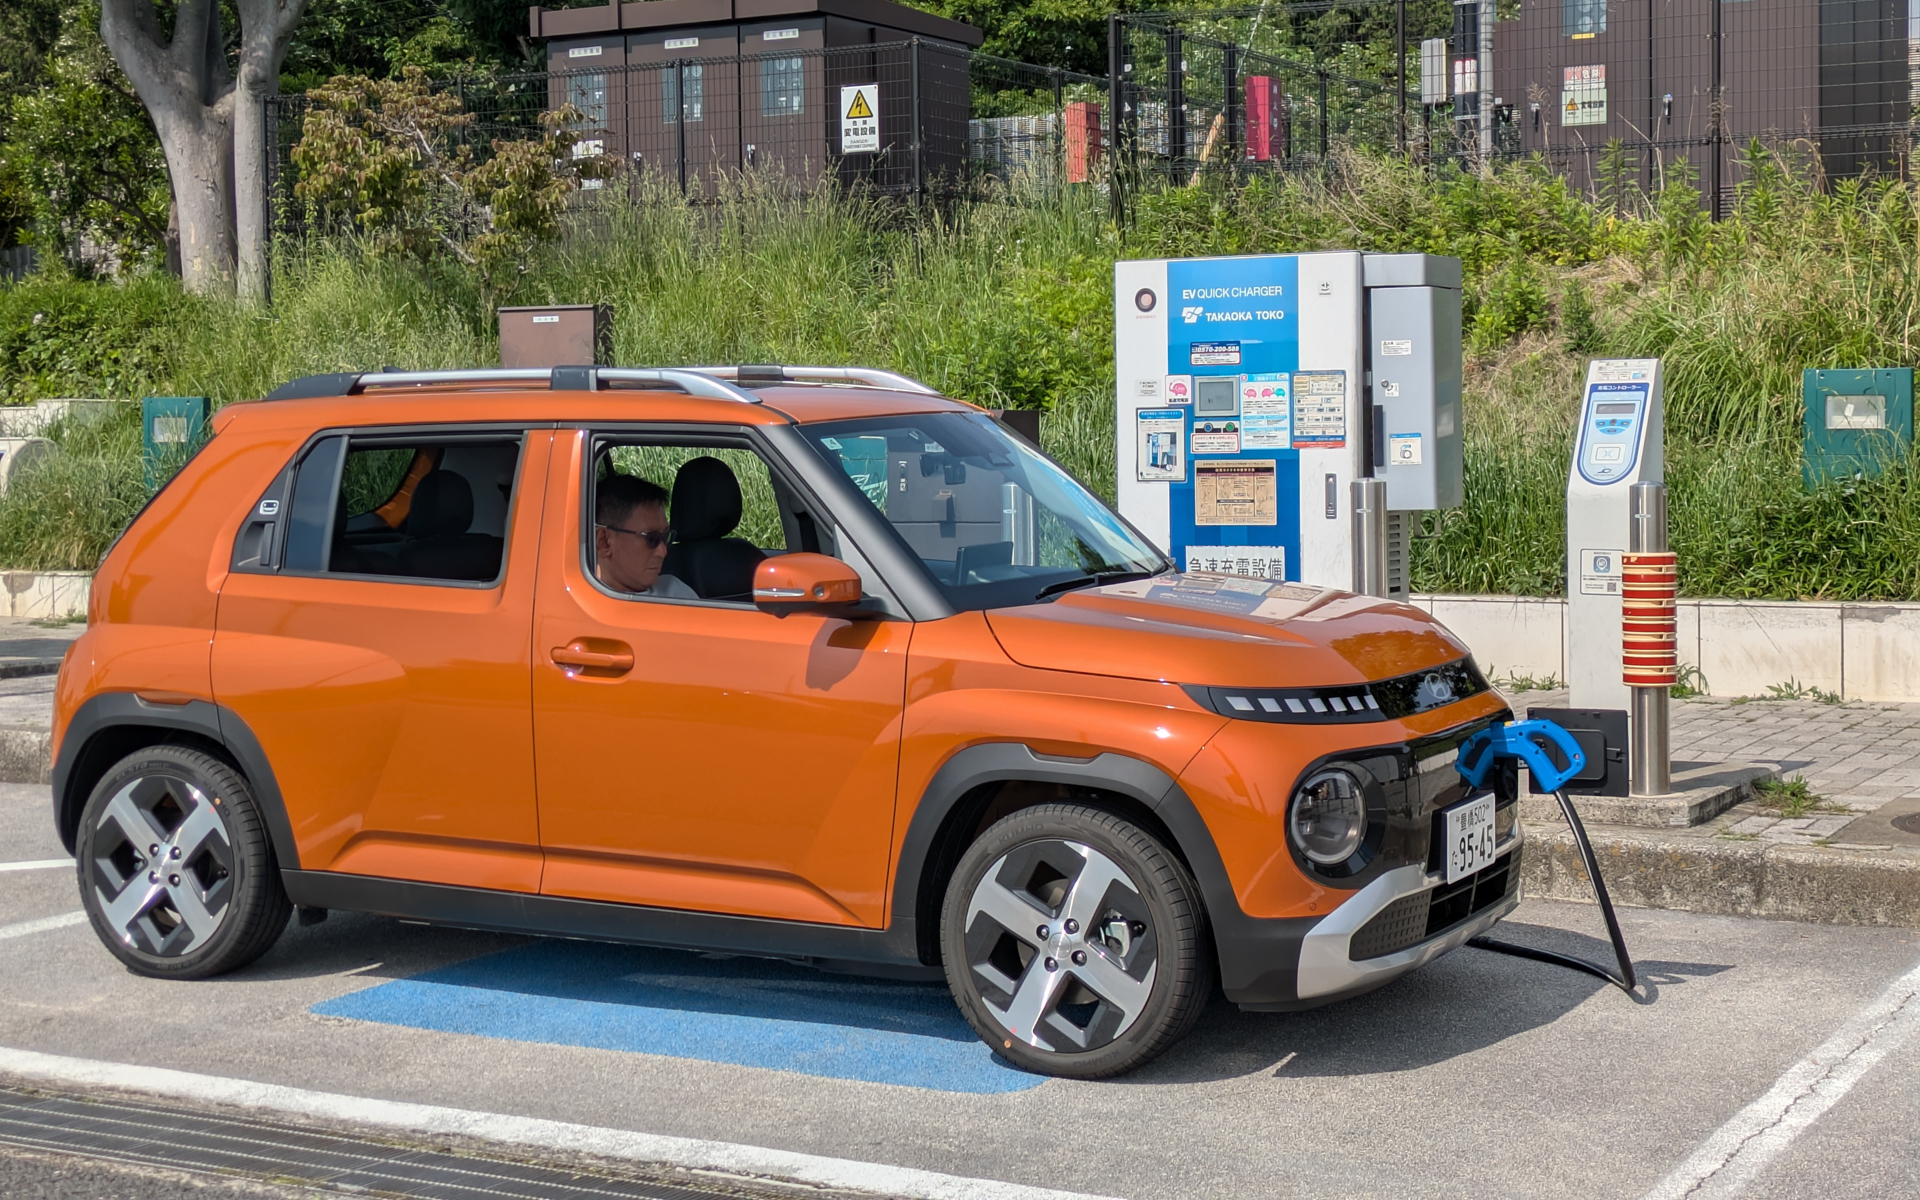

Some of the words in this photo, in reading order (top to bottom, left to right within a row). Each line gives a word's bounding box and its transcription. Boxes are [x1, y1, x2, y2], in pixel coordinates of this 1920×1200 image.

[844, 127, 876, 137] 変電設備
[1182, 289, 1196, 299] EV
[1197, 287, 1230, 299] QUICK
[1231, 285, 1283, 297] CHARGER
[1205, 311, 1253, 322] TAKAOKA
[1255, 310, 1284, 320] TOKO
[1189, 557, 1283, 580] 急速充電設備
[1474, 803, 1486, 826] 502
[998, 823, 1044, 845] KUMHO
[1459, 823, 1494, 872] 95-45
